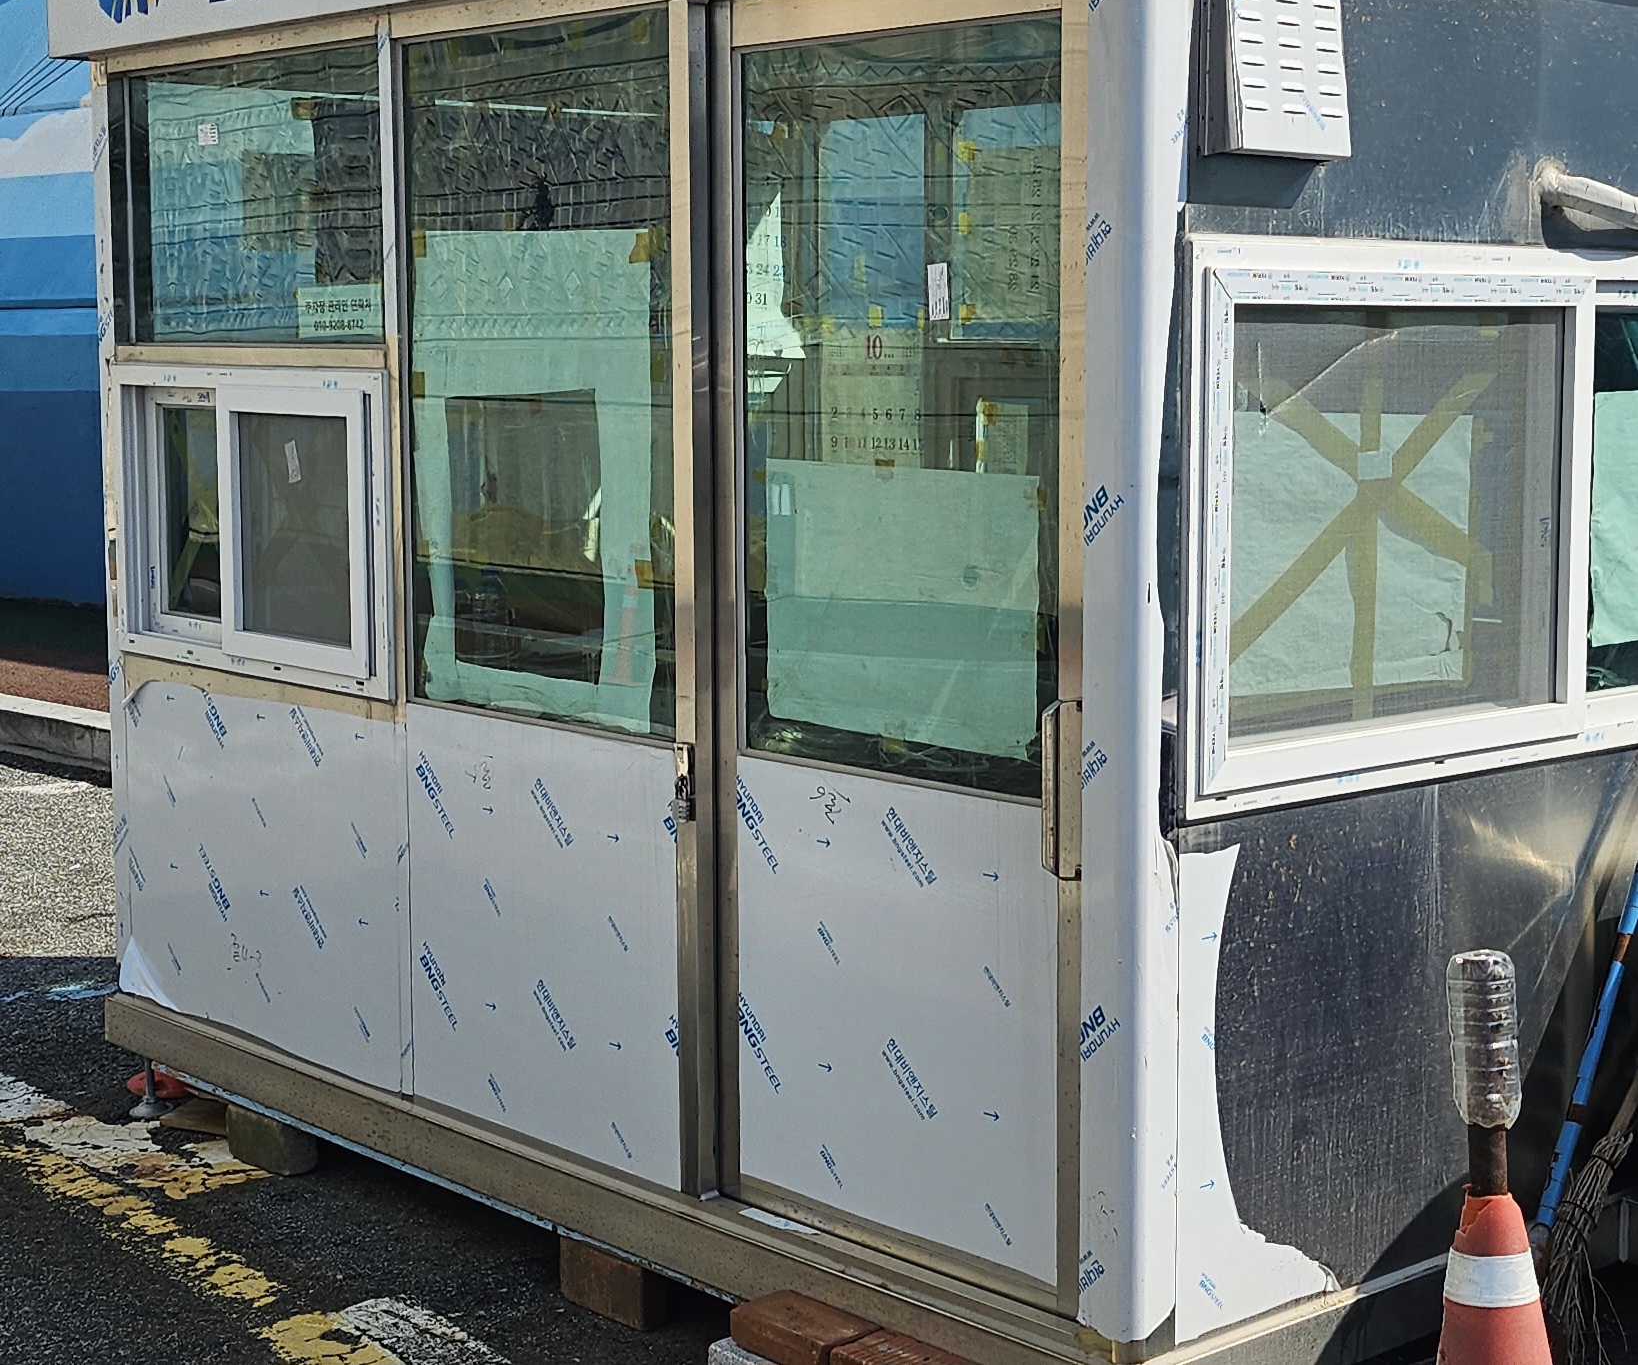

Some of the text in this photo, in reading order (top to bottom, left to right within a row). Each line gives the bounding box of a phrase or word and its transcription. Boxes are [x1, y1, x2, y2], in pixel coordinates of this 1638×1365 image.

[755, 292, 768, 305] 31
[866, 334, 883, 360] 10
[872, 408, 879, 420] 5
[885, 408, 892, 420] 6
[899, 408, 906, 421] 7
[914, 409, 922, 422] 8
[831, 436, 838, 448] 9
[871, 437, 883, 449] 12
[884, 437, 896, 450] 13
[899, 438, 909, 451] 14
[1084, 495, 1125, 546] HYUNDAI
[204, 710, 225, 750] HYUNDAI
[418, 750, 443, 795] HYUNDAI
[415, 764, 456, 840] BNGSTEEL
[530, 789, 564, 849] www.bngsteel.com
[534, 777, 574, 847] 현대비앤지스틸
[736, 774, 765, 824] HYUNDAI
[881, 819, 925, 888] www.bngsteel.com
[885, 806, 937, 885] 현대비앤지스틸
[198, 842, 231, 911] BNGSTEEL
[422, 941, 447, 986] HYUNDAI
[419, 954, 459, 1032] BNGSTEEL
[536, 978, 577, 1050] 현대비앤지스틸
[738, 992, 766, 1043] HYUNDAI
[1080, 1017, 1121, 1062] HYUNDAI
[881, 1049, 925, 1121] www.bngsteel.com
[886, 1037, 938, 1120] 현대비앤지스틸
[819, 1150, 844, 1189] BNGSTEEL
[1079, 1259, 1106, 1293] 현대비
